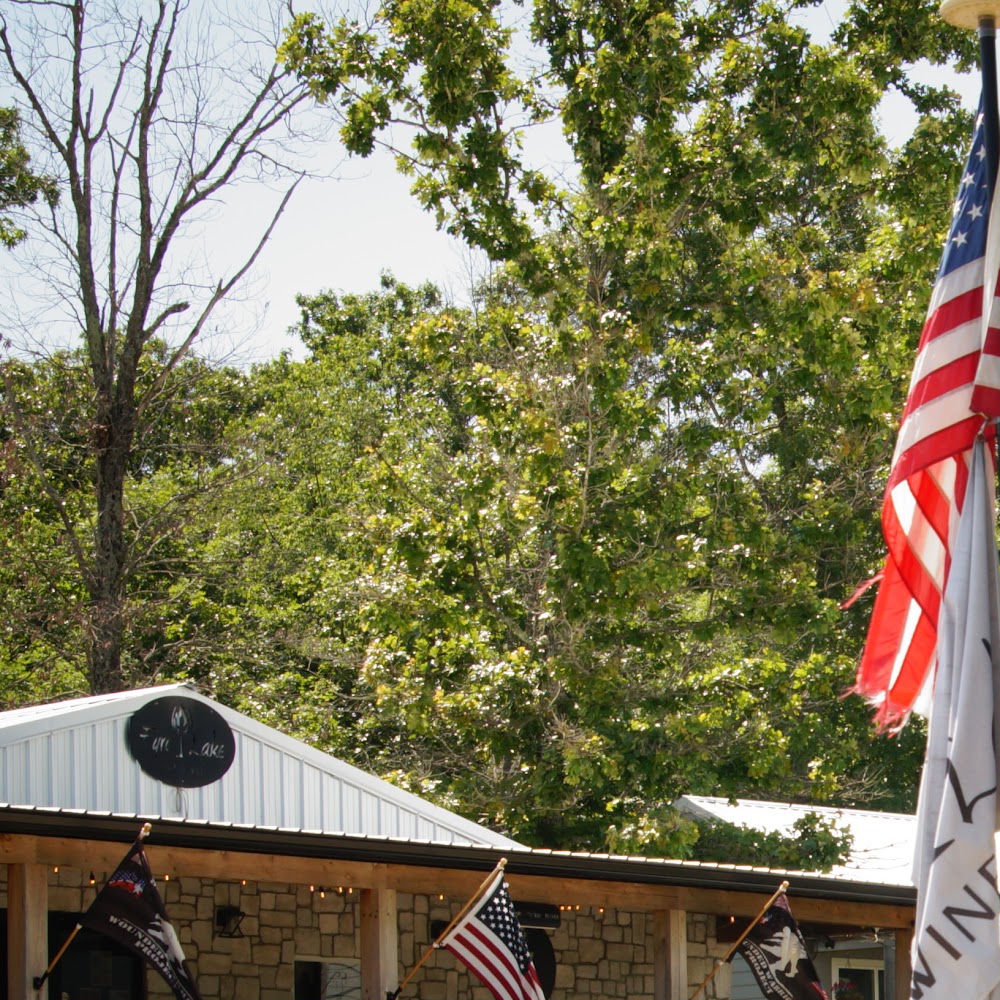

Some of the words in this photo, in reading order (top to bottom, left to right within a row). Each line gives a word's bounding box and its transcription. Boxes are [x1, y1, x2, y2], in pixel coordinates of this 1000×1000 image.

[109, 914, 165, 959] WOUNDED
[742, 940, 768, 969] UNDED
[744, 950, 774, 994] PROJECT
